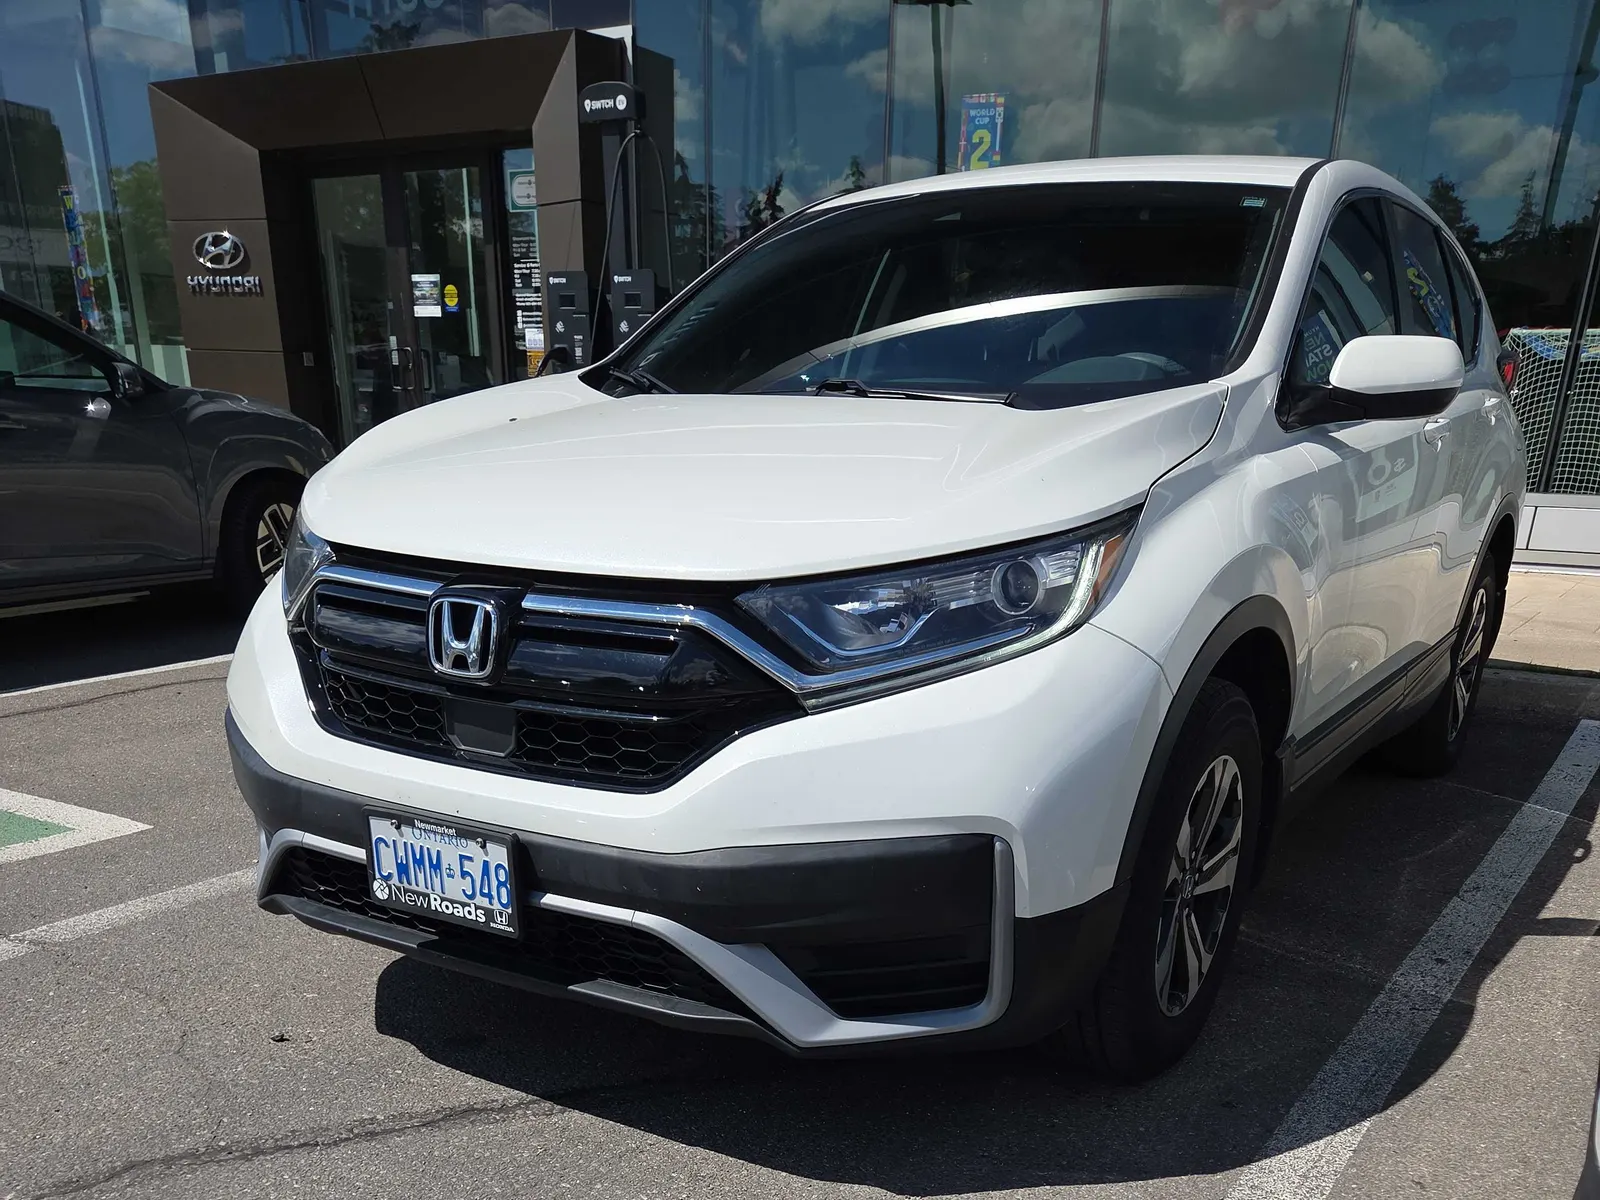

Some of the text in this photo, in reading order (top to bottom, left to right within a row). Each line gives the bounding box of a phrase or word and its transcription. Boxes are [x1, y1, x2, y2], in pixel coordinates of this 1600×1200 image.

[969, 108, 995, 117] WORLD
[975, 117, 990, 125] CUP
[970, 129, 991, 171] 2
[186, 275, 261, 293] HYUNDAI
[414, 818, 457, 836] Newmarket
[411, 827, 469, 850] ONTARIO
[374, 836, 512, 910] CWMM 548
[489, 921, 515, 933] HONDA
